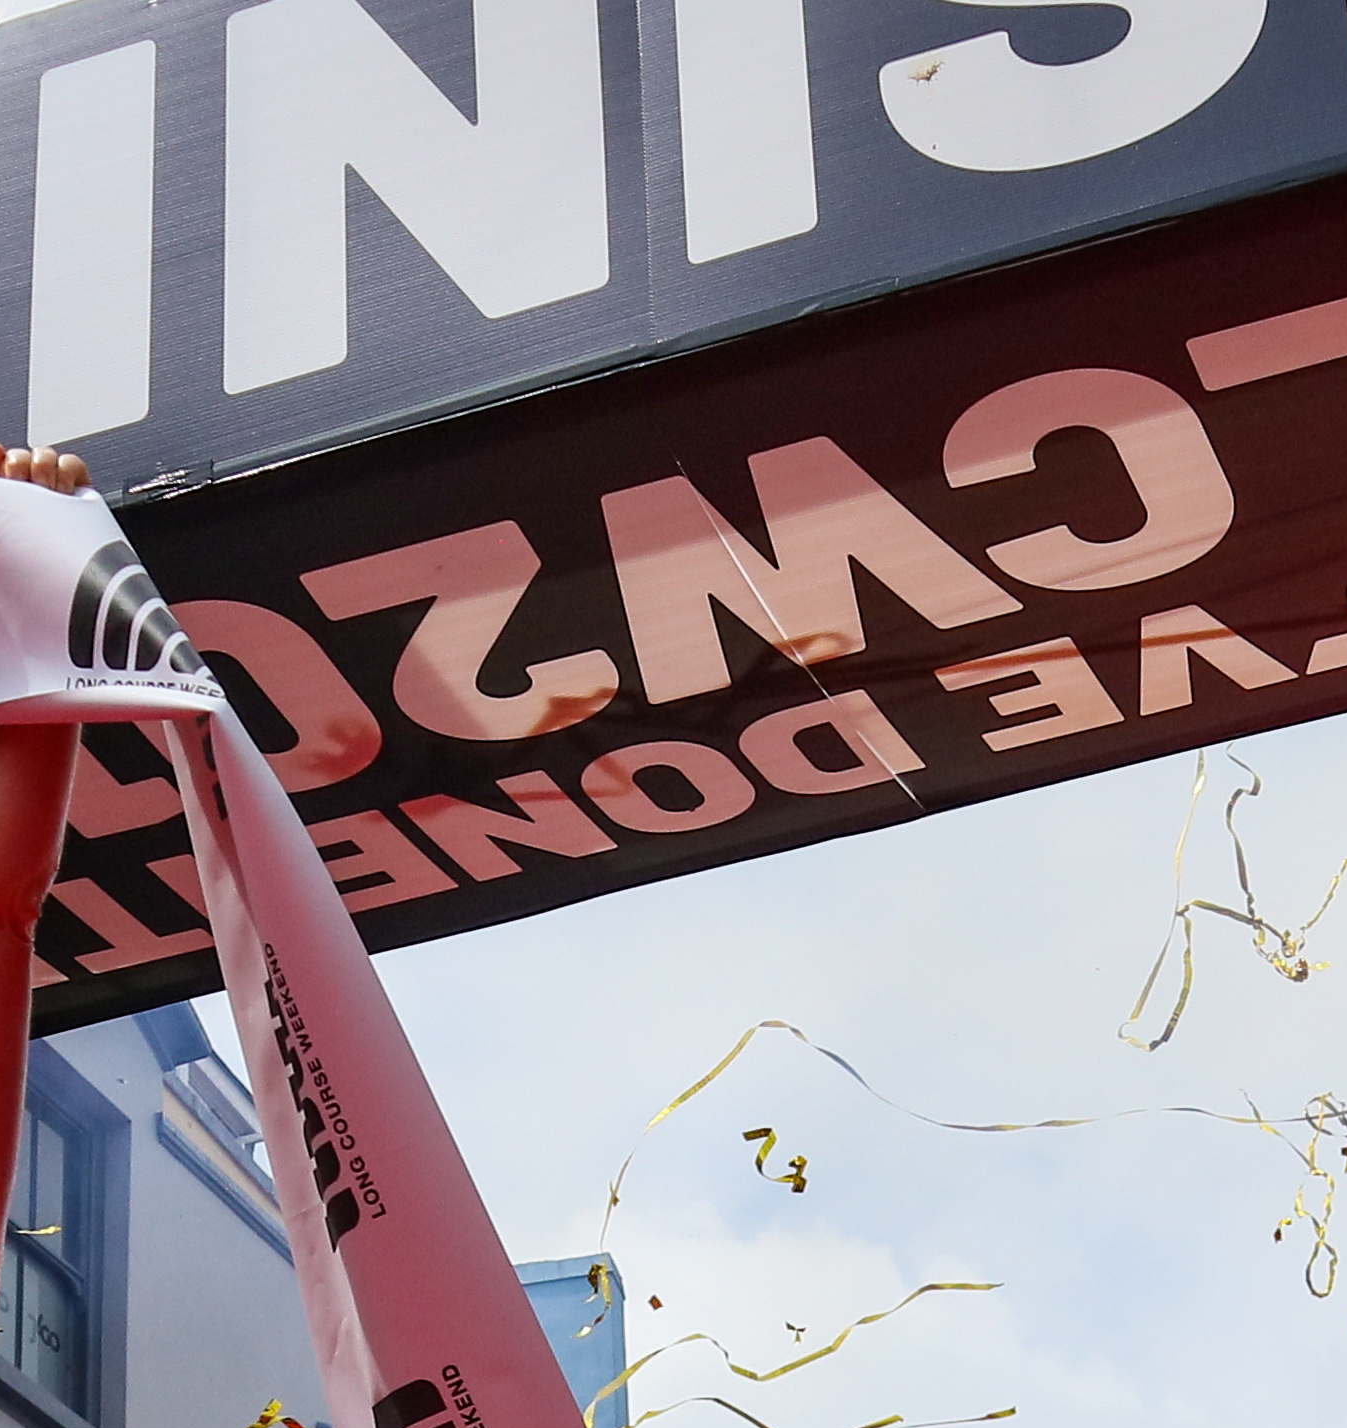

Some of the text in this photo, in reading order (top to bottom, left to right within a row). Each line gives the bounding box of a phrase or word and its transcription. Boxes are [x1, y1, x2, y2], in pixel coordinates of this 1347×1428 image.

[307, 694, 926, 914] DONE
[264, 943, 387, 1219] LONG COURSE WEEKEND
